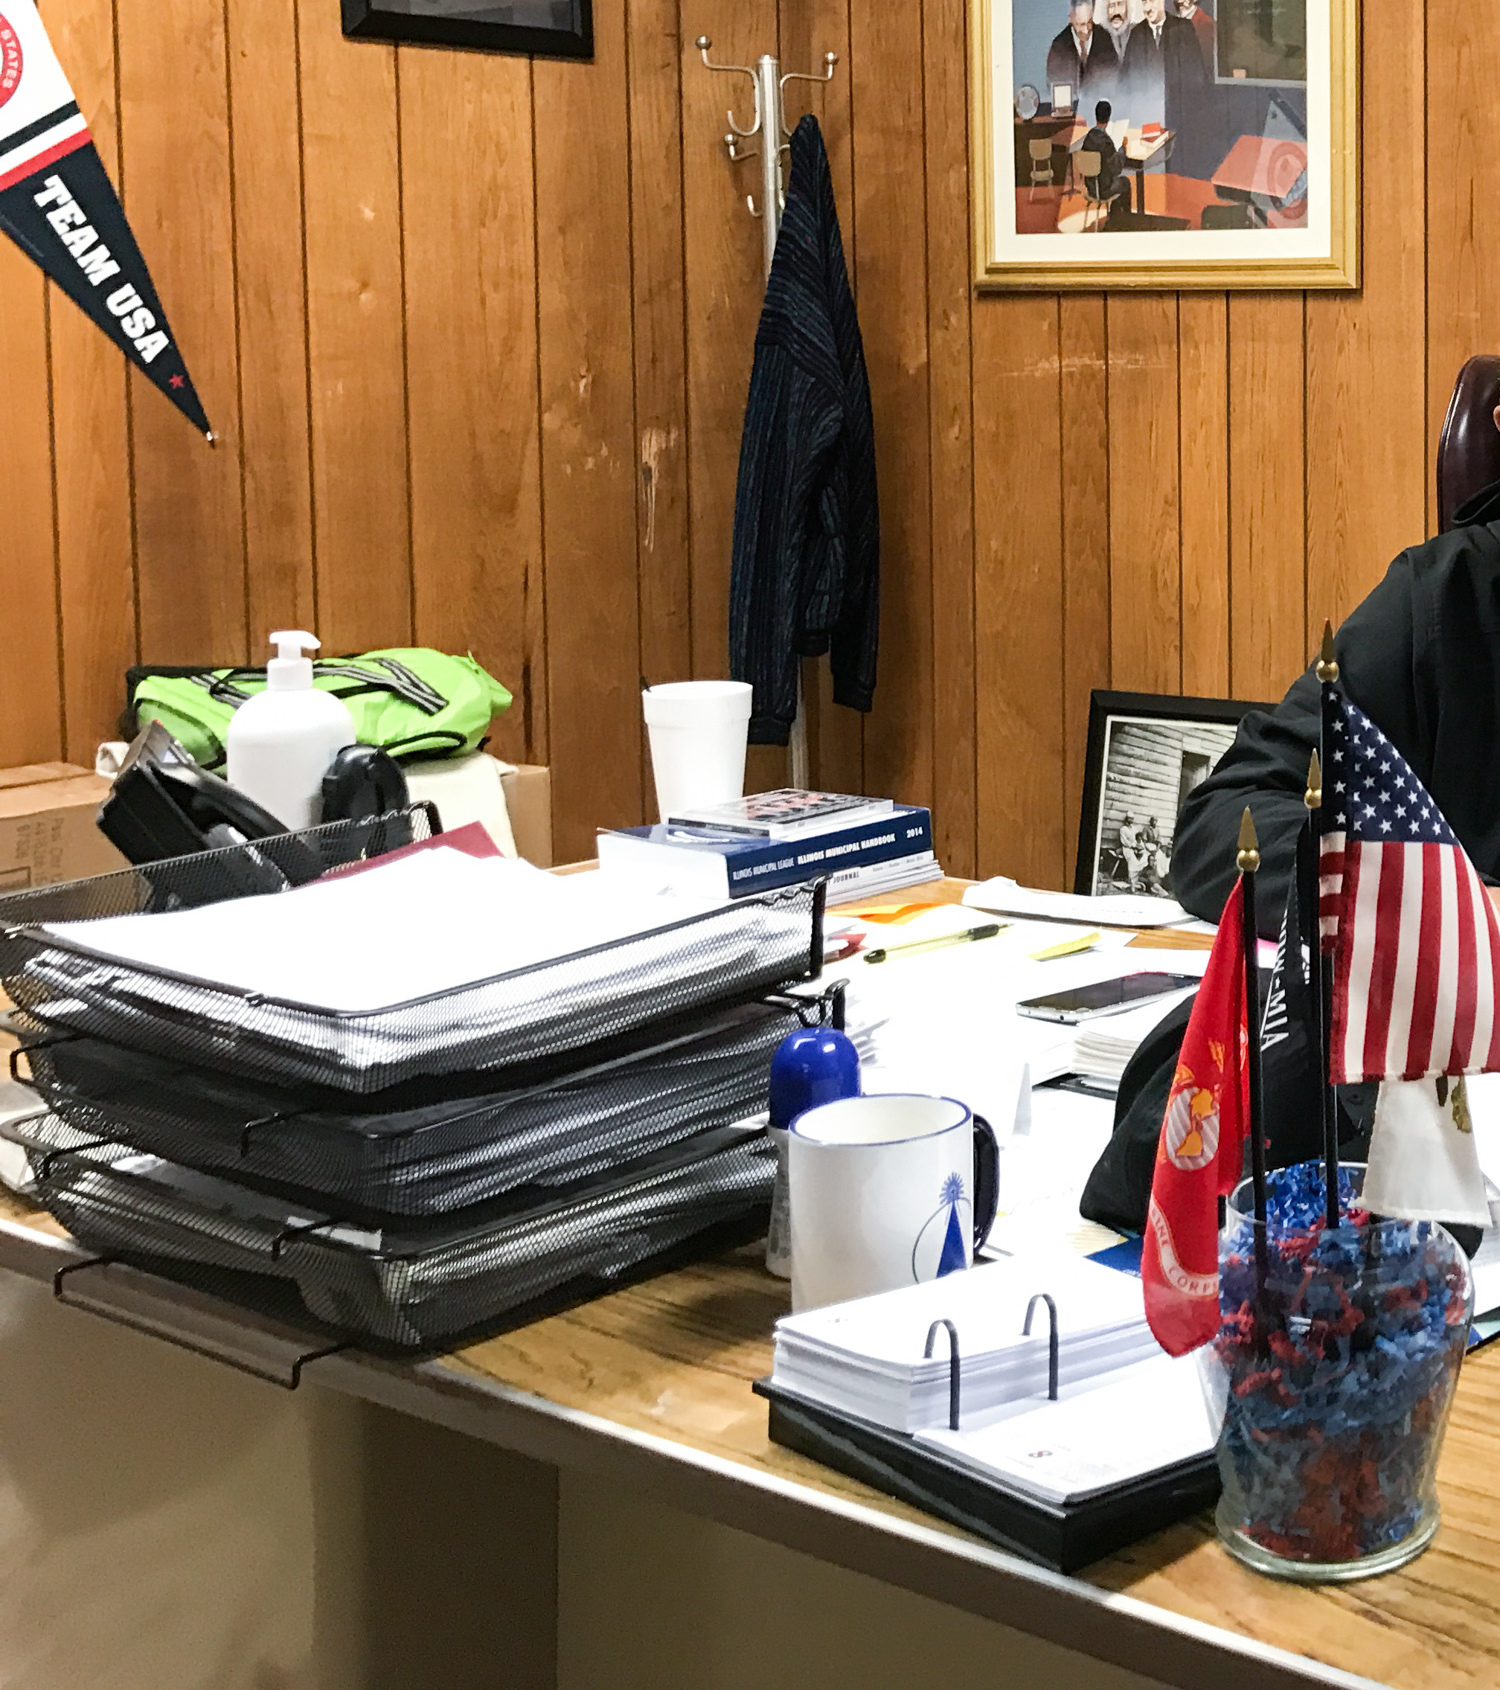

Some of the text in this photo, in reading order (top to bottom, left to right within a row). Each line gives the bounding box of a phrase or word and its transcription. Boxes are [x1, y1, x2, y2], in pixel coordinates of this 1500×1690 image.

[1, 29, 20, 90] STATES
[33, 174, 170, 364] TEAM USA
[732, 867, 753, 881] ILLINOIS
[753, 861, 777, 876] MUNICIPAL
[797, 850, 824, 865] ILLINOIS
[825, 841, 860, 859] MUNICIPAL
[860, 832, 896, 850] HANDBOOK
[906, 826, 924, 839] 2014
[833, 871, 860, 884] JOURNAL
[1260, 989, 1289, 1052] MIA
